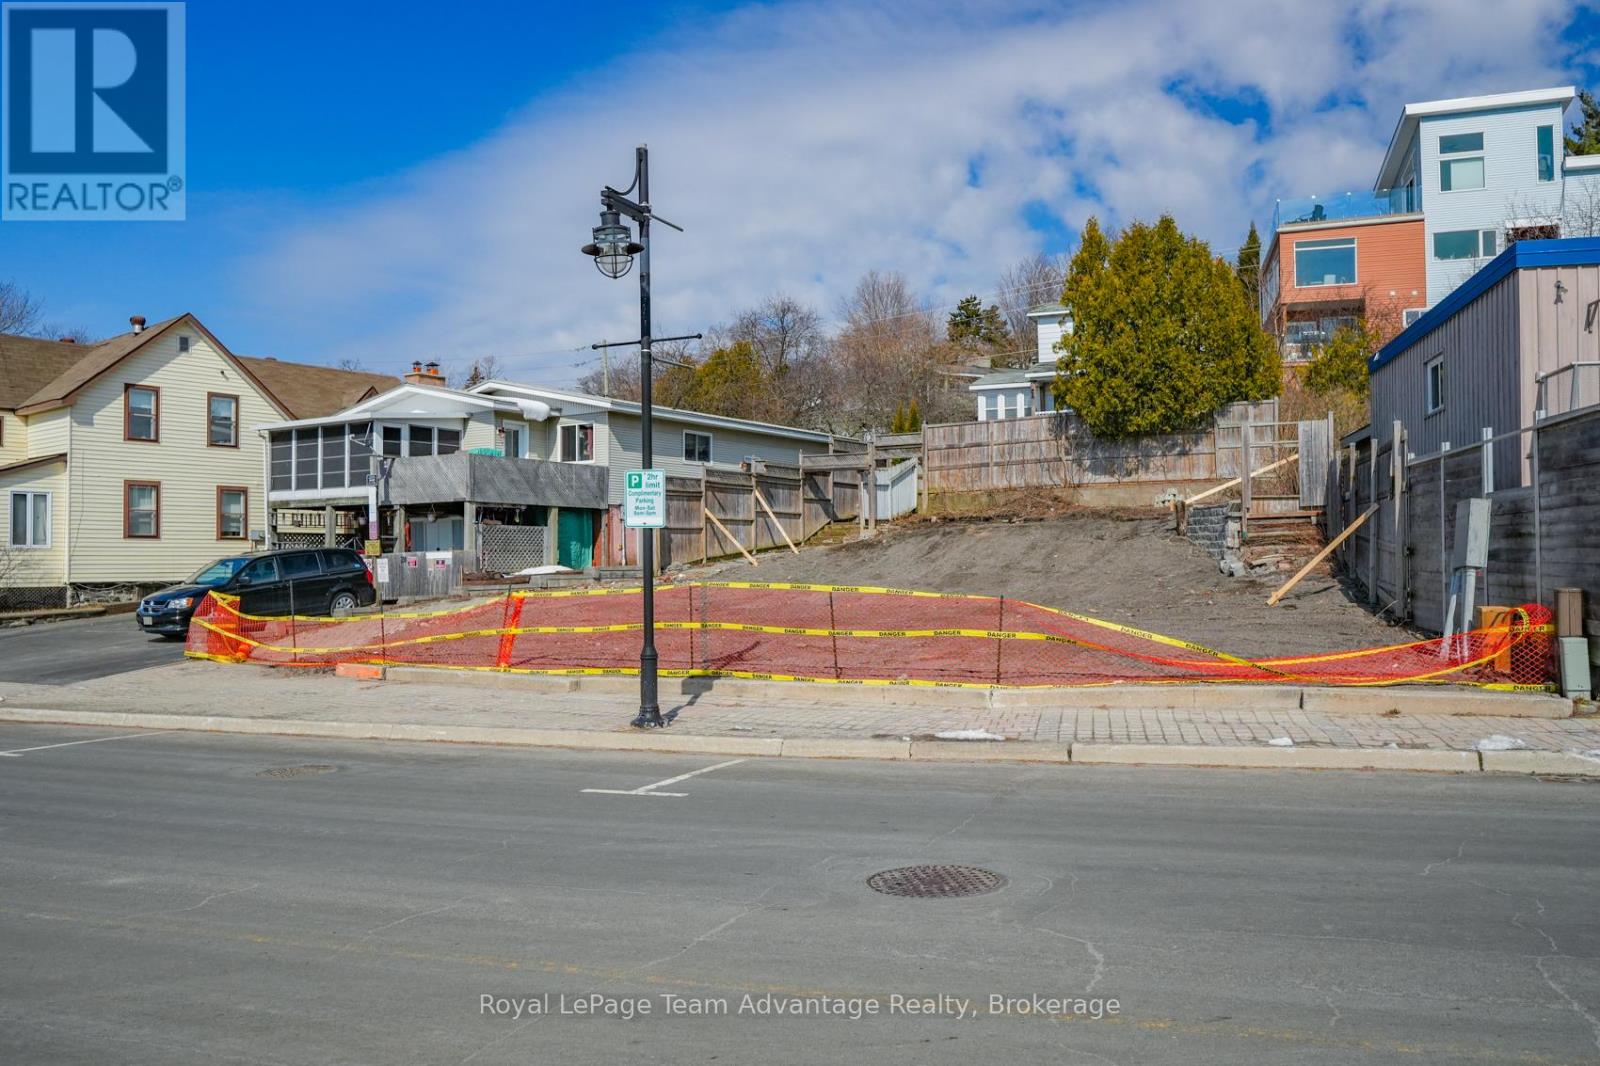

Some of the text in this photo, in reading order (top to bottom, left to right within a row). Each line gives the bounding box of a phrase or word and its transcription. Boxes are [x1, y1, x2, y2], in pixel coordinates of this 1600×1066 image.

[1045, 635, 1077, 645] DANGER
[1121, 626, 1153, 639] DANGER
[1185, 642, 1219, 657] DANGER
[1513, 684, 1551, 692] DANGER
